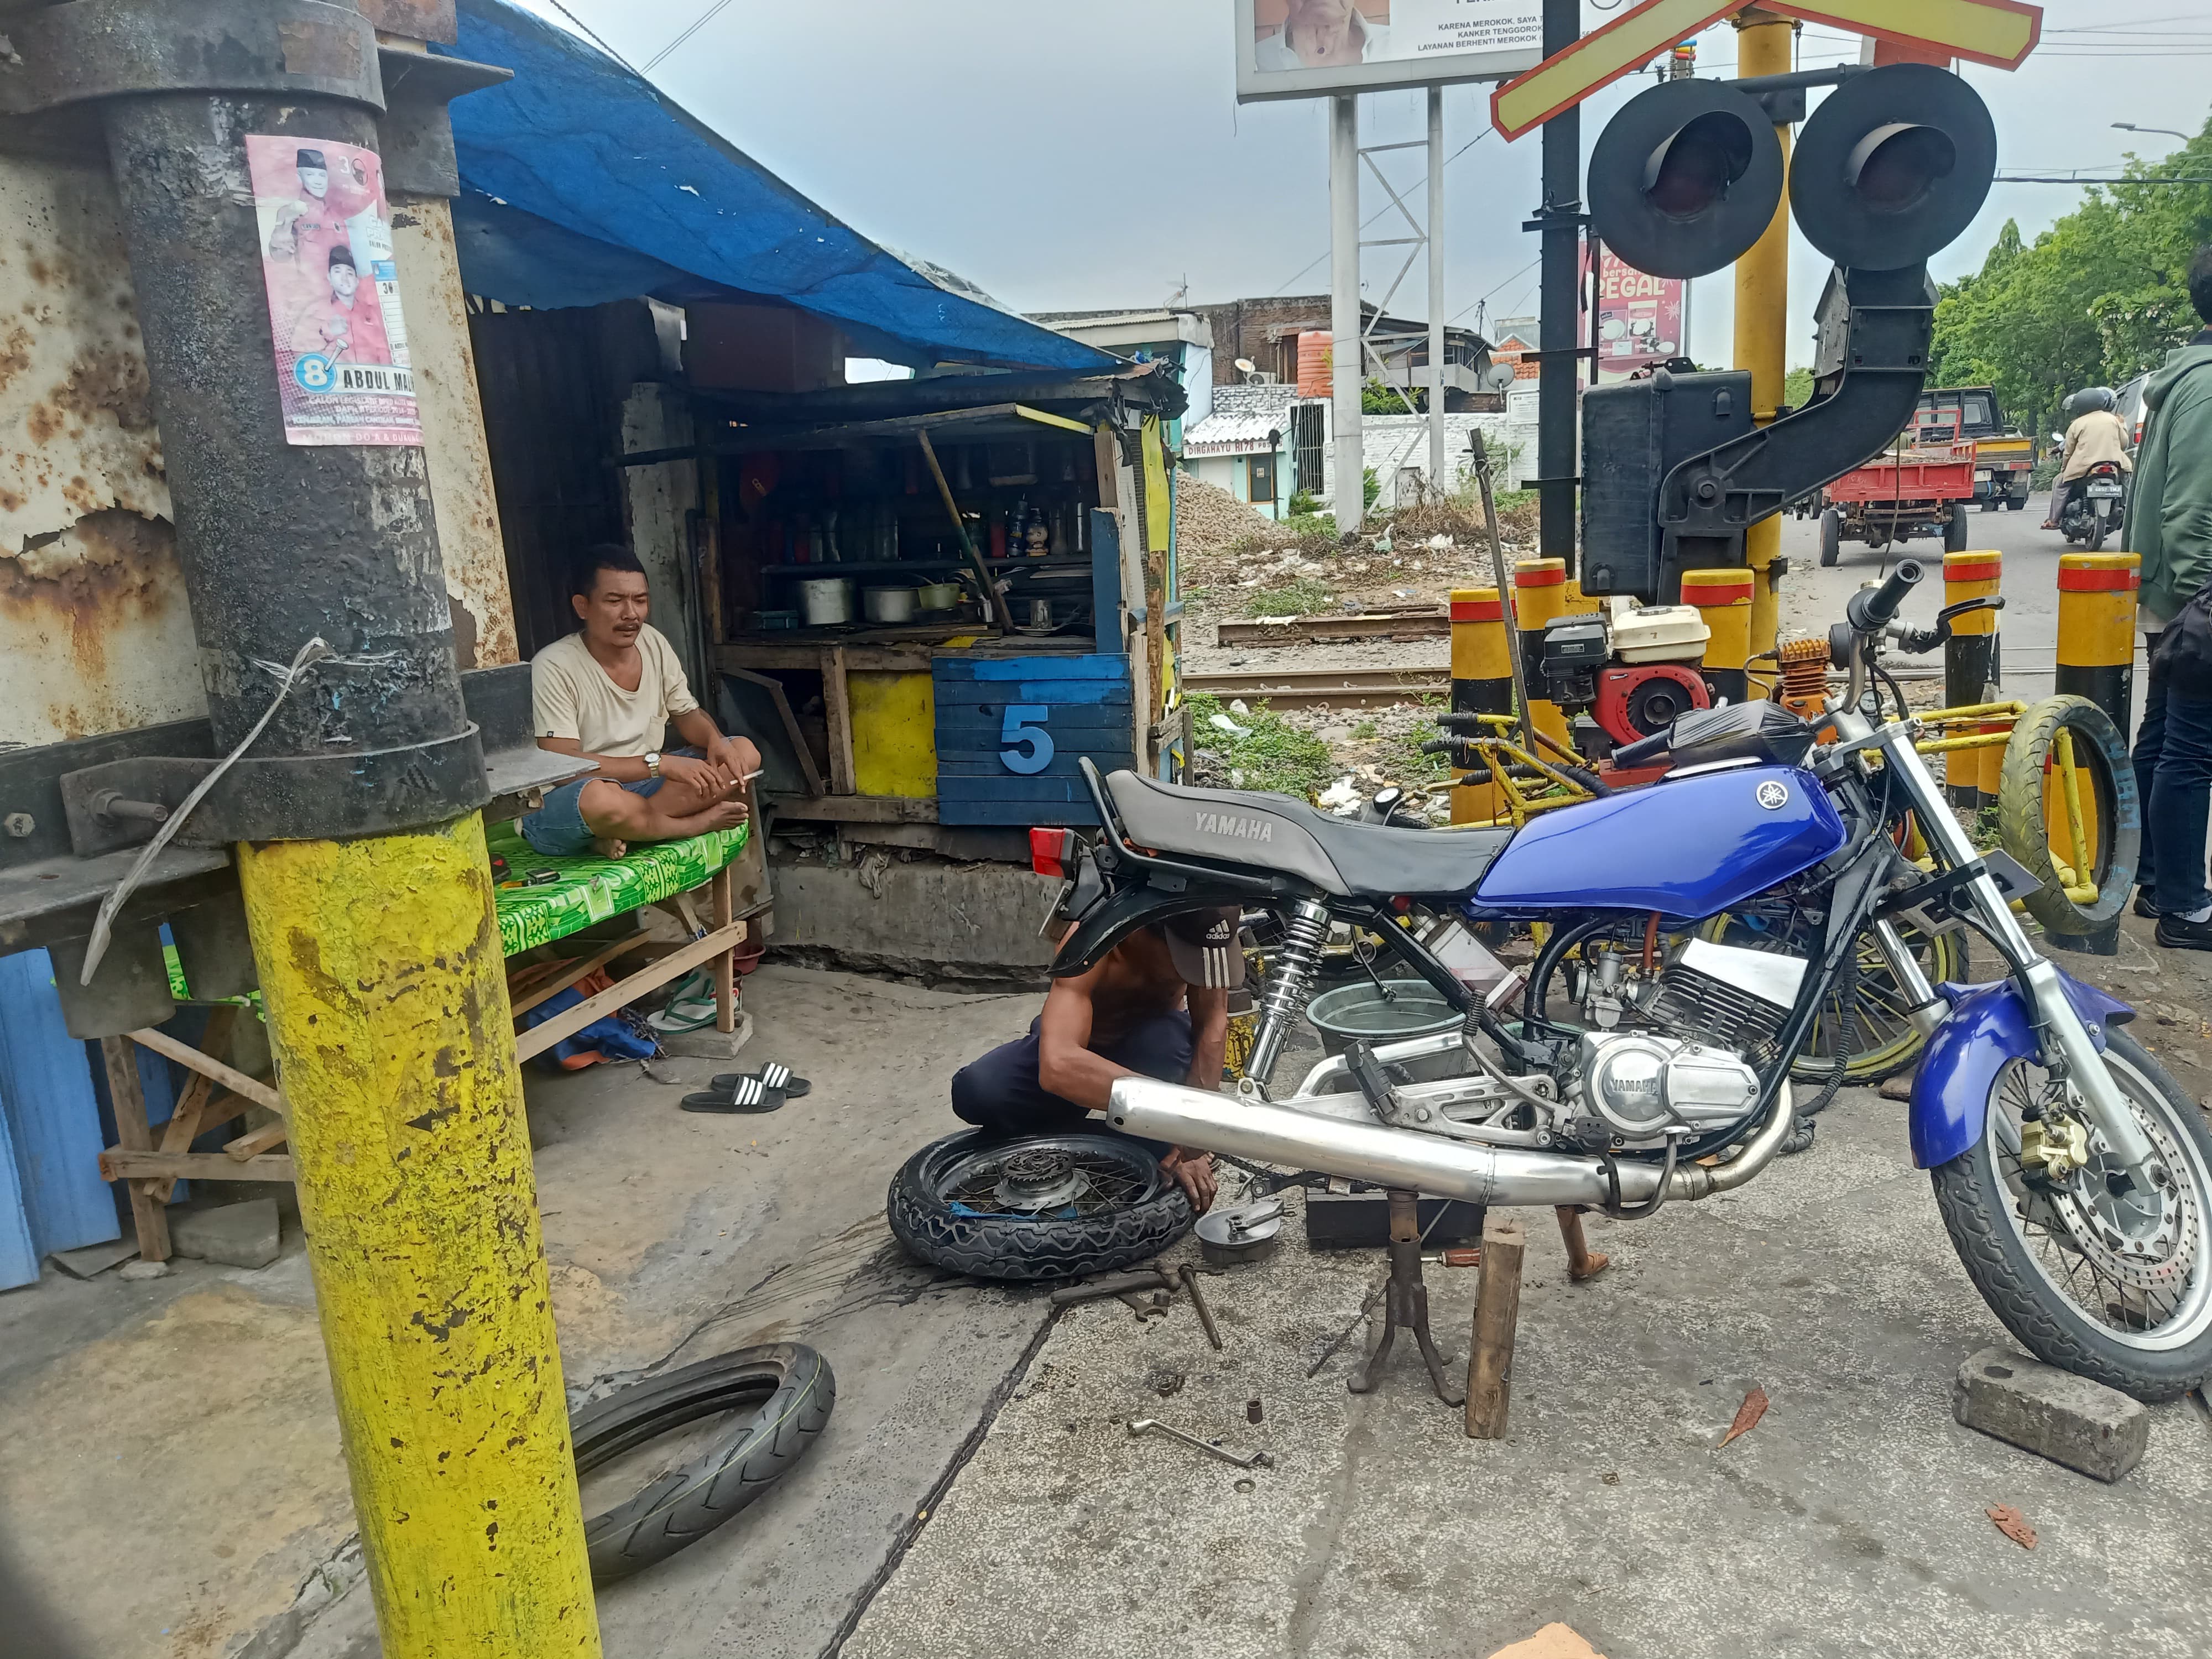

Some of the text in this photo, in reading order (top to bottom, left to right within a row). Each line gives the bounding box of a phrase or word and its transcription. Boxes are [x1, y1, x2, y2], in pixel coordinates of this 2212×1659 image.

[1438, 22, 1472, 30] KARENA
[1458, 29, 1490, 38] KANKER
[1418, 41, 1454, 51] LAYANAN
[1456, 38, 1495, 48] BERHENTI
[1497, 35, 1537, 44] MEROKOK
[338, 155, 351, 175] 3
[304, 359, 328, 386] 8
[343, 370, 390, 390] ABDUL
[1188, 443, 1231, 455] DIRGAHAYU
[999, 705, 1054, 774] 5
[1195, 811, 1272, 842] YAMAHA
[1610, 1079, 1659, 1095] YAMAHA
